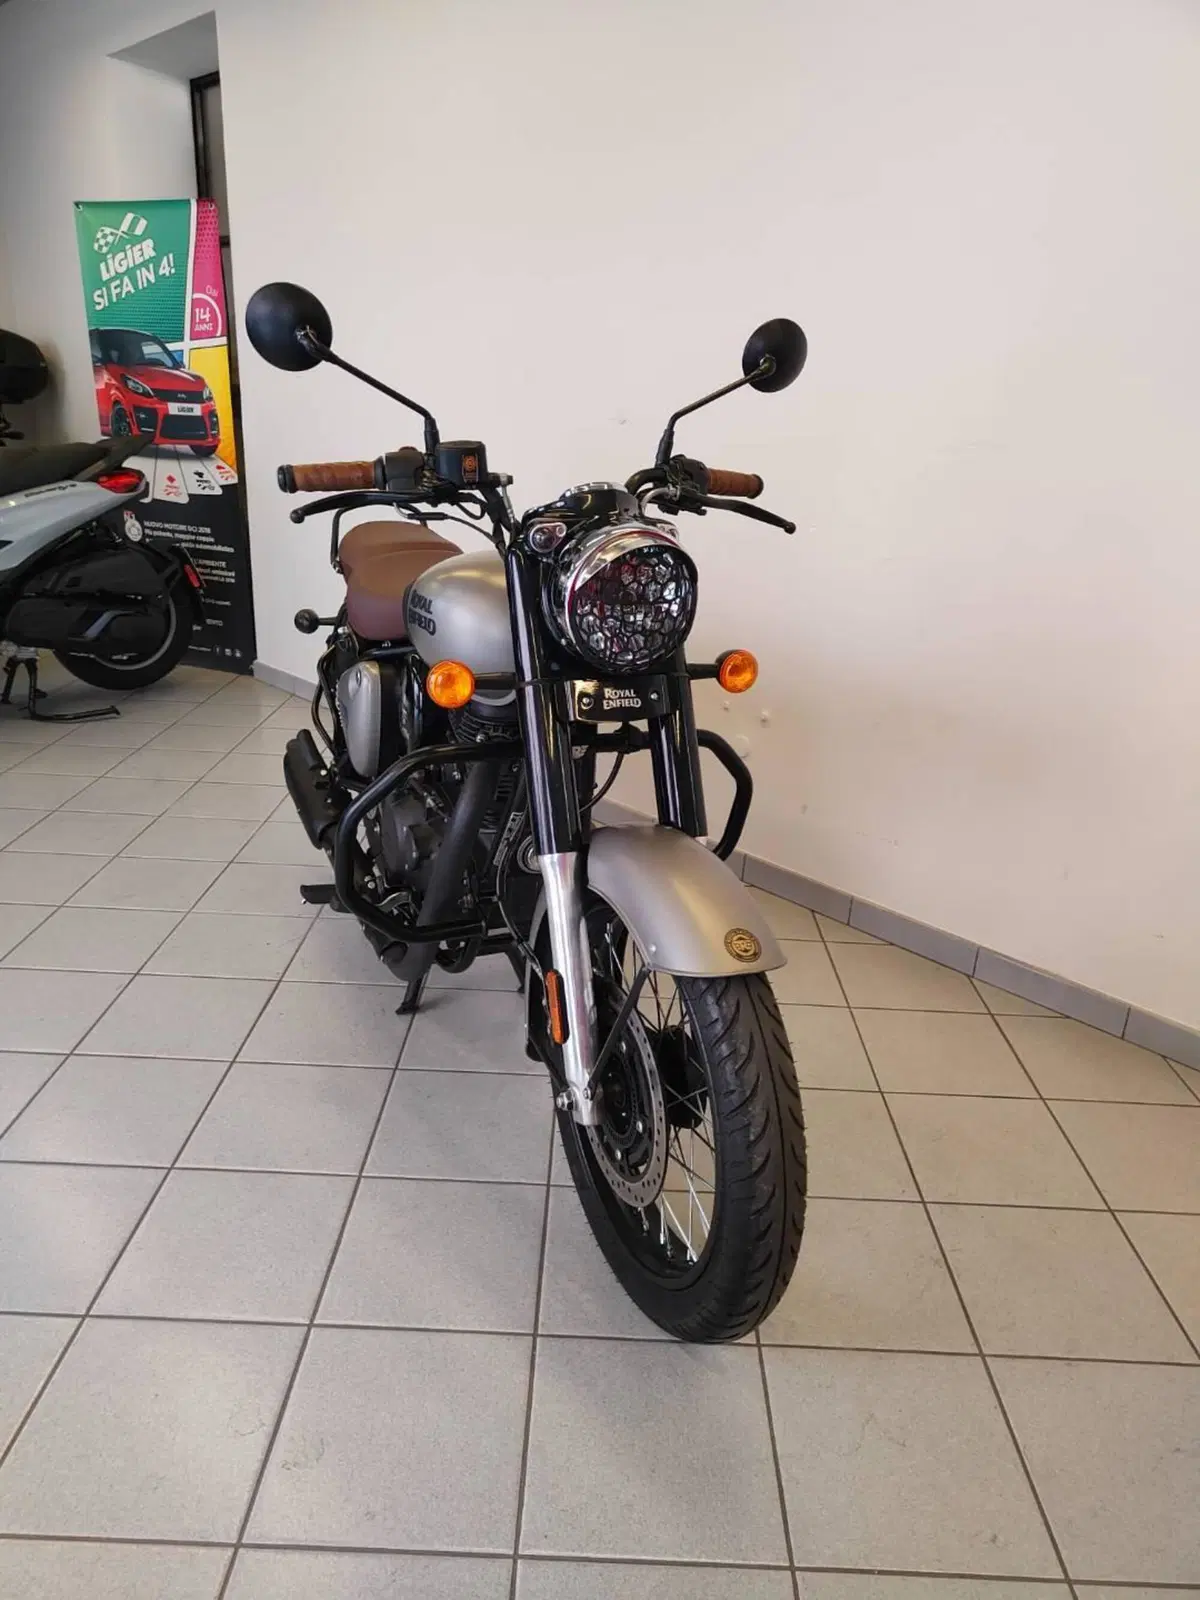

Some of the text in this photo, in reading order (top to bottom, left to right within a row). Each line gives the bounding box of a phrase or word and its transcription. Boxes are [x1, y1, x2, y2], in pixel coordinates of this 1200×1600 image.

[93, 253, 176, 311] SI FA IN 4!
[194, 307, 211, 323] 14
[603, 688, 636, 699] ROYAL
[603, 698, 641, 710] ENFIELD
